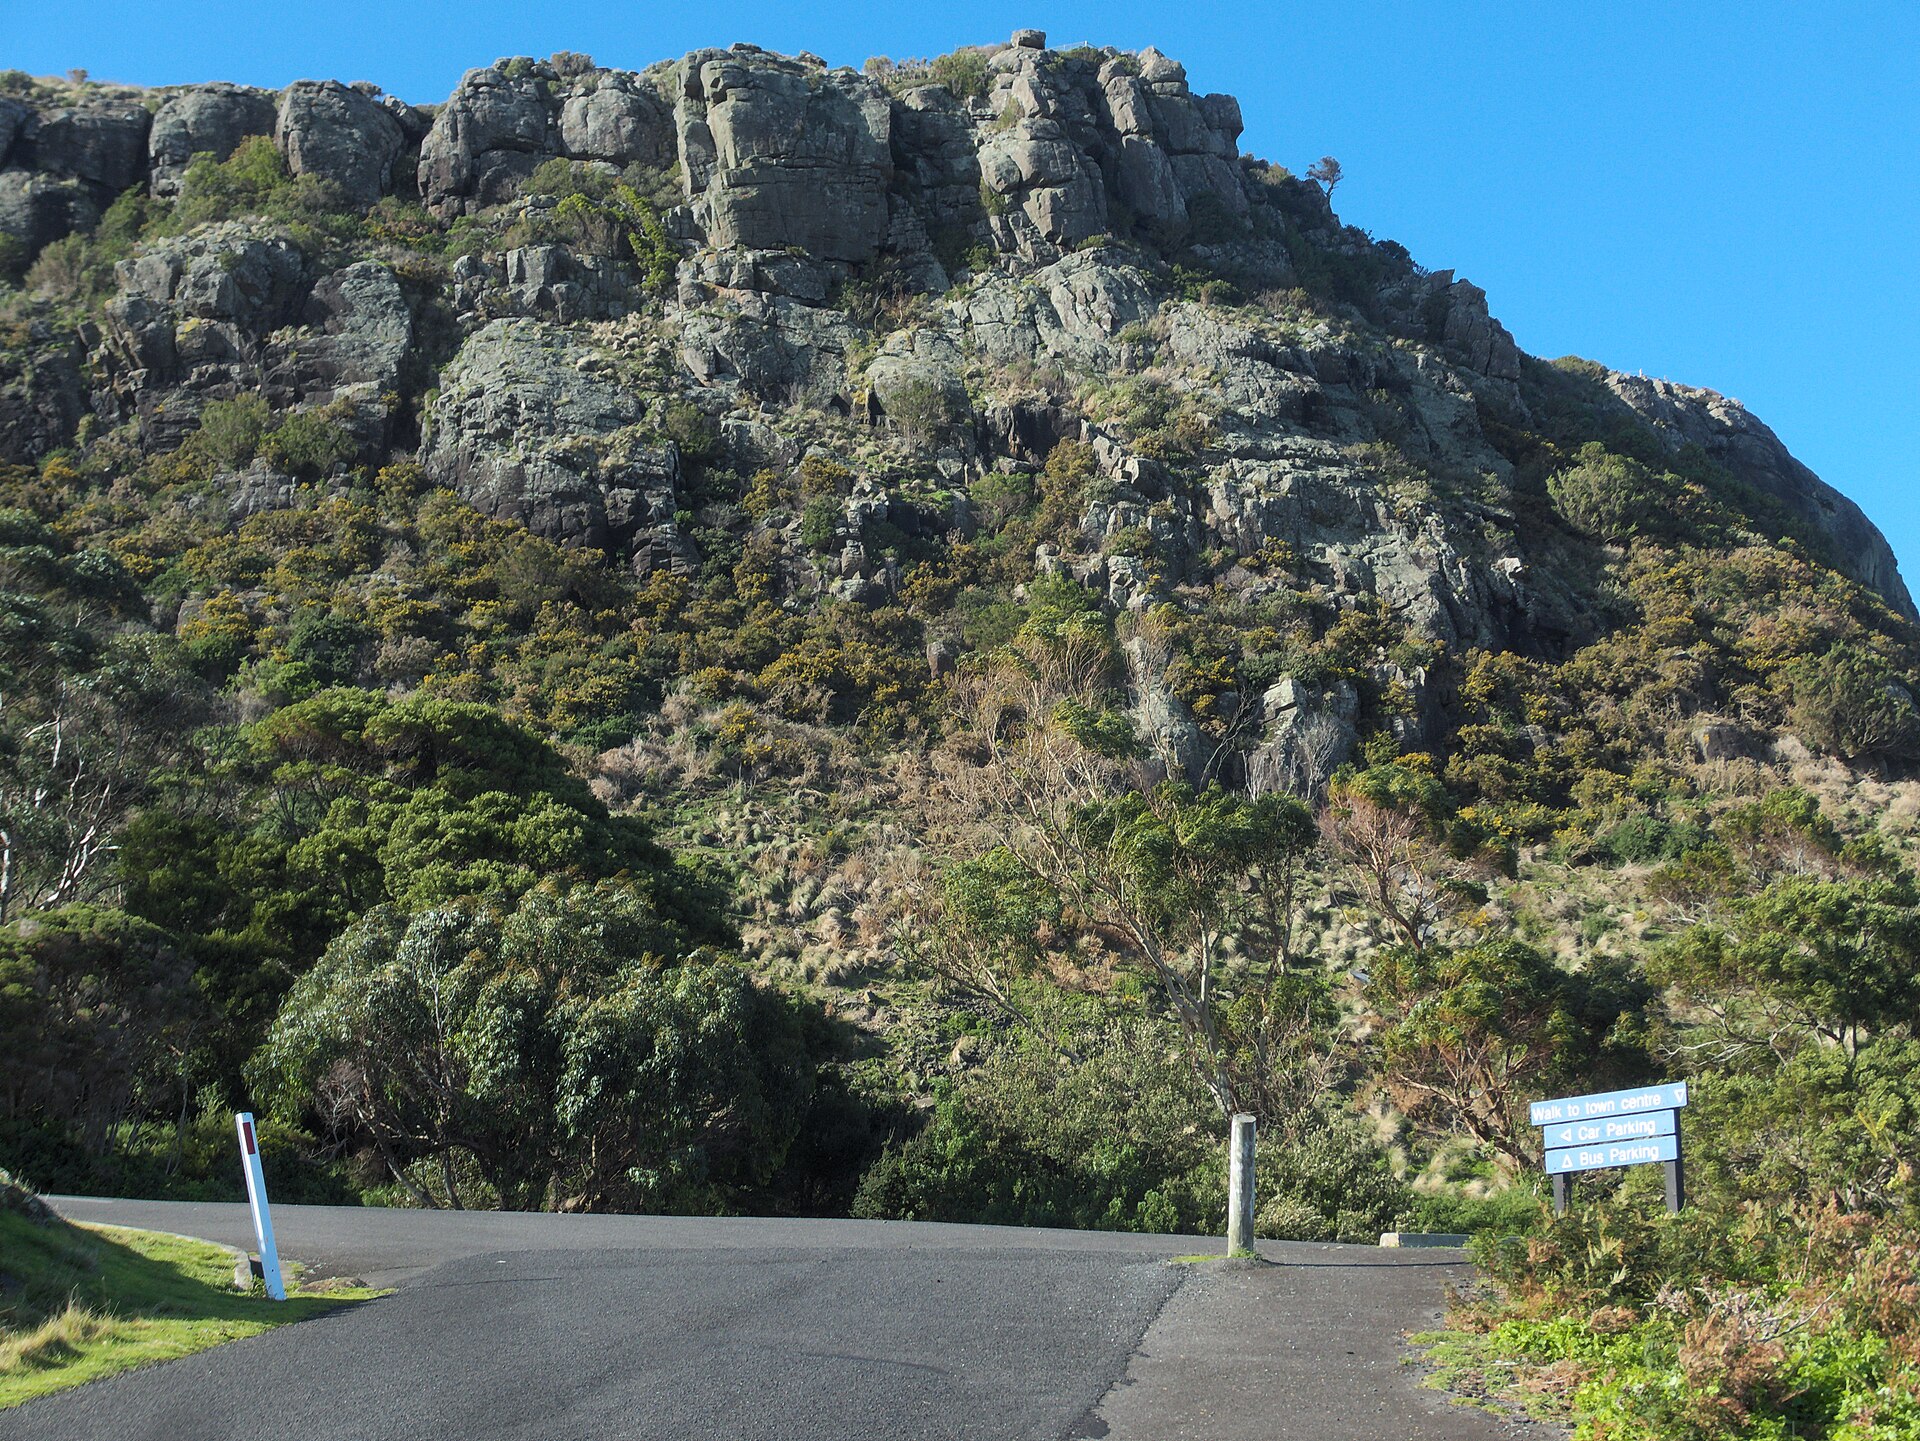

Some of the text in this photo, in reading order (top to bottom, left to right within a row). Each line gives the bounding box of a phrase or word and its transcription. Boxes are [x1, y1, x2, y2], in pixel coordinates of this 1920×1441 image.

[1532, 1093, 1661, 1121] Walk to town centre
[1578, 1119, 1656, 1141] Car Parking
[1580, 1145, 1659, 1166] Bus Parking
